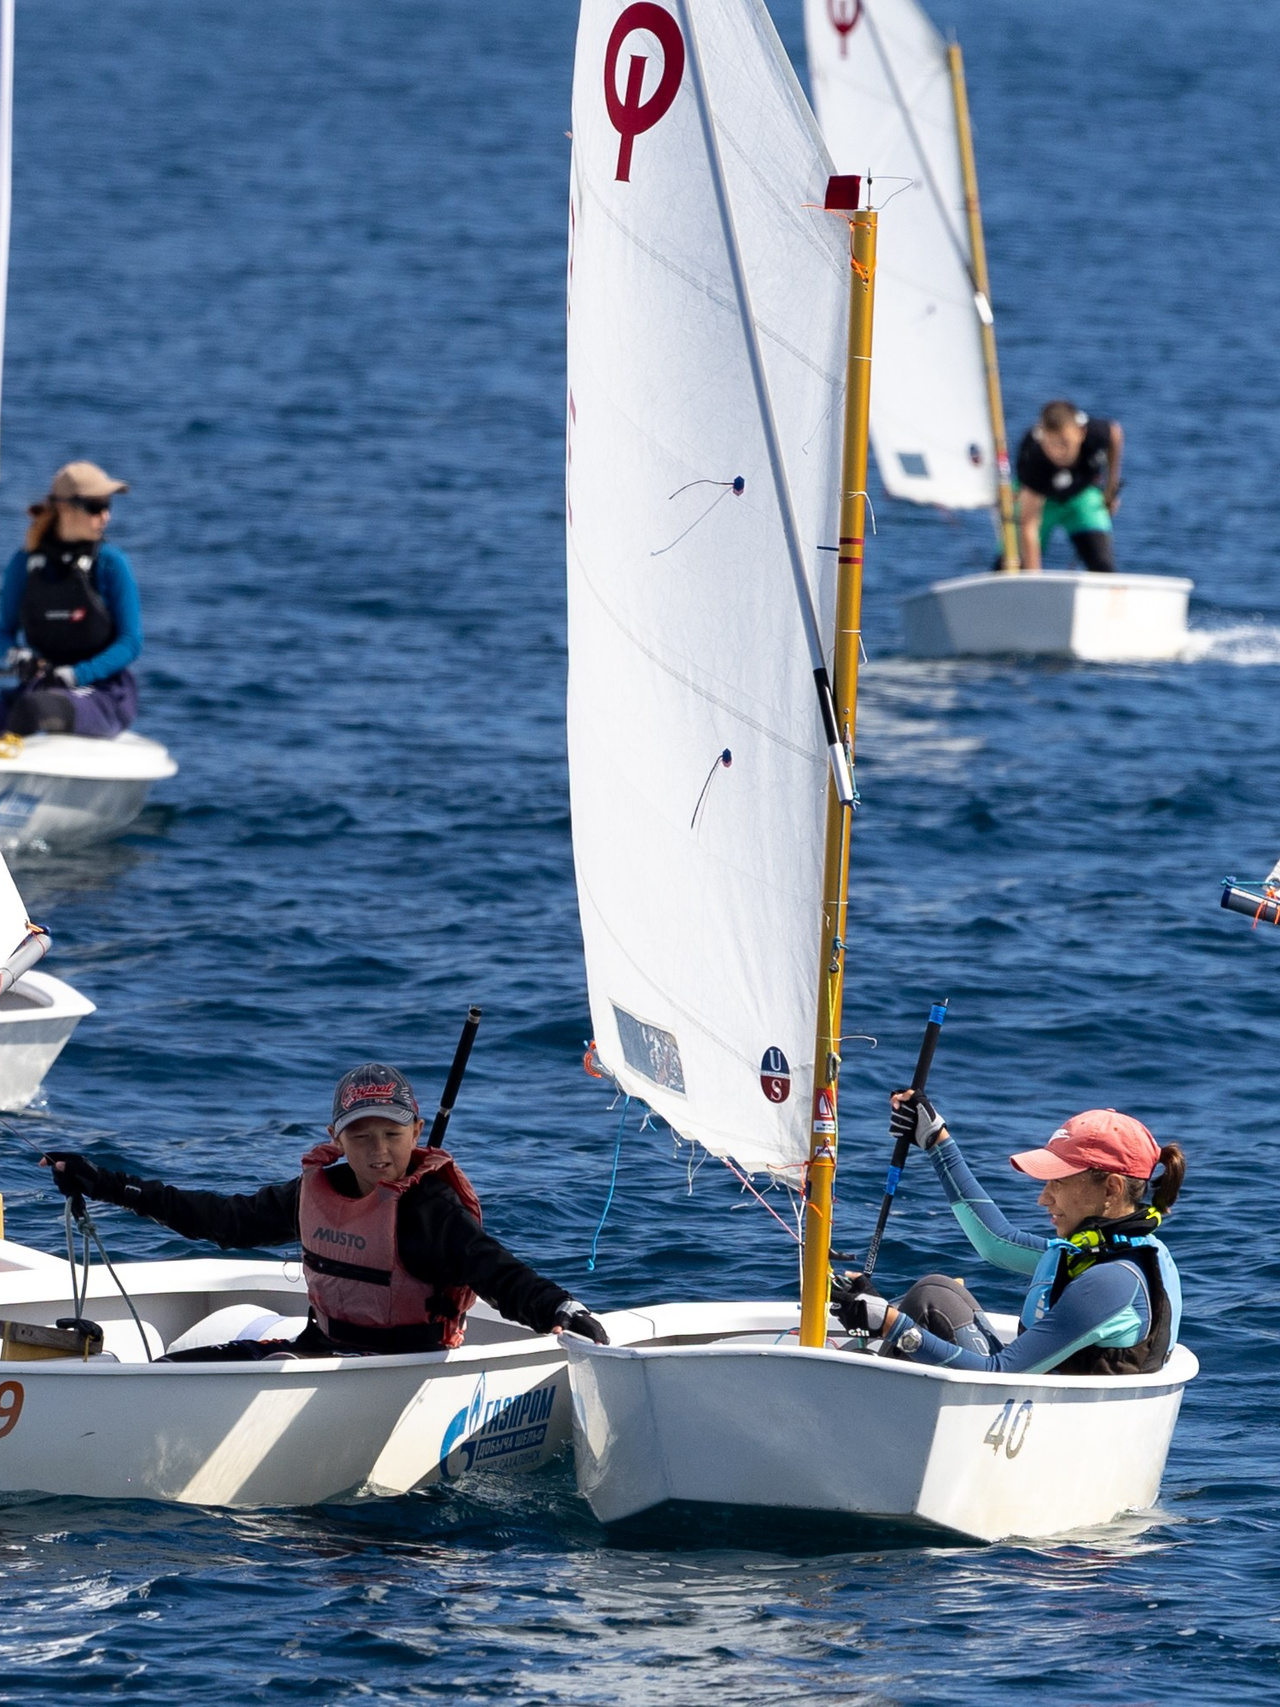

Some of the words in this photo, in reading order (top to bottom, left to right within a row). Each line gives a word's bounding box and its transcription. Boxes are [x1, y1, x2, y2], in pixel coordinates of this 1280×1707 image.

[769, 1049, 782, 1072] U
[770, 1079, 783, 1101] S
[312, 1226, 367, 1251] MUSTO
[480, 1384, 557, 1436] ГАЗПРОМ
[983, 1398, 1034, 1460] 40
[477, 1435, 514, 1459] ДОБЫЧА
[514, 1428, 546, 1448] ШЕЛЬФ
